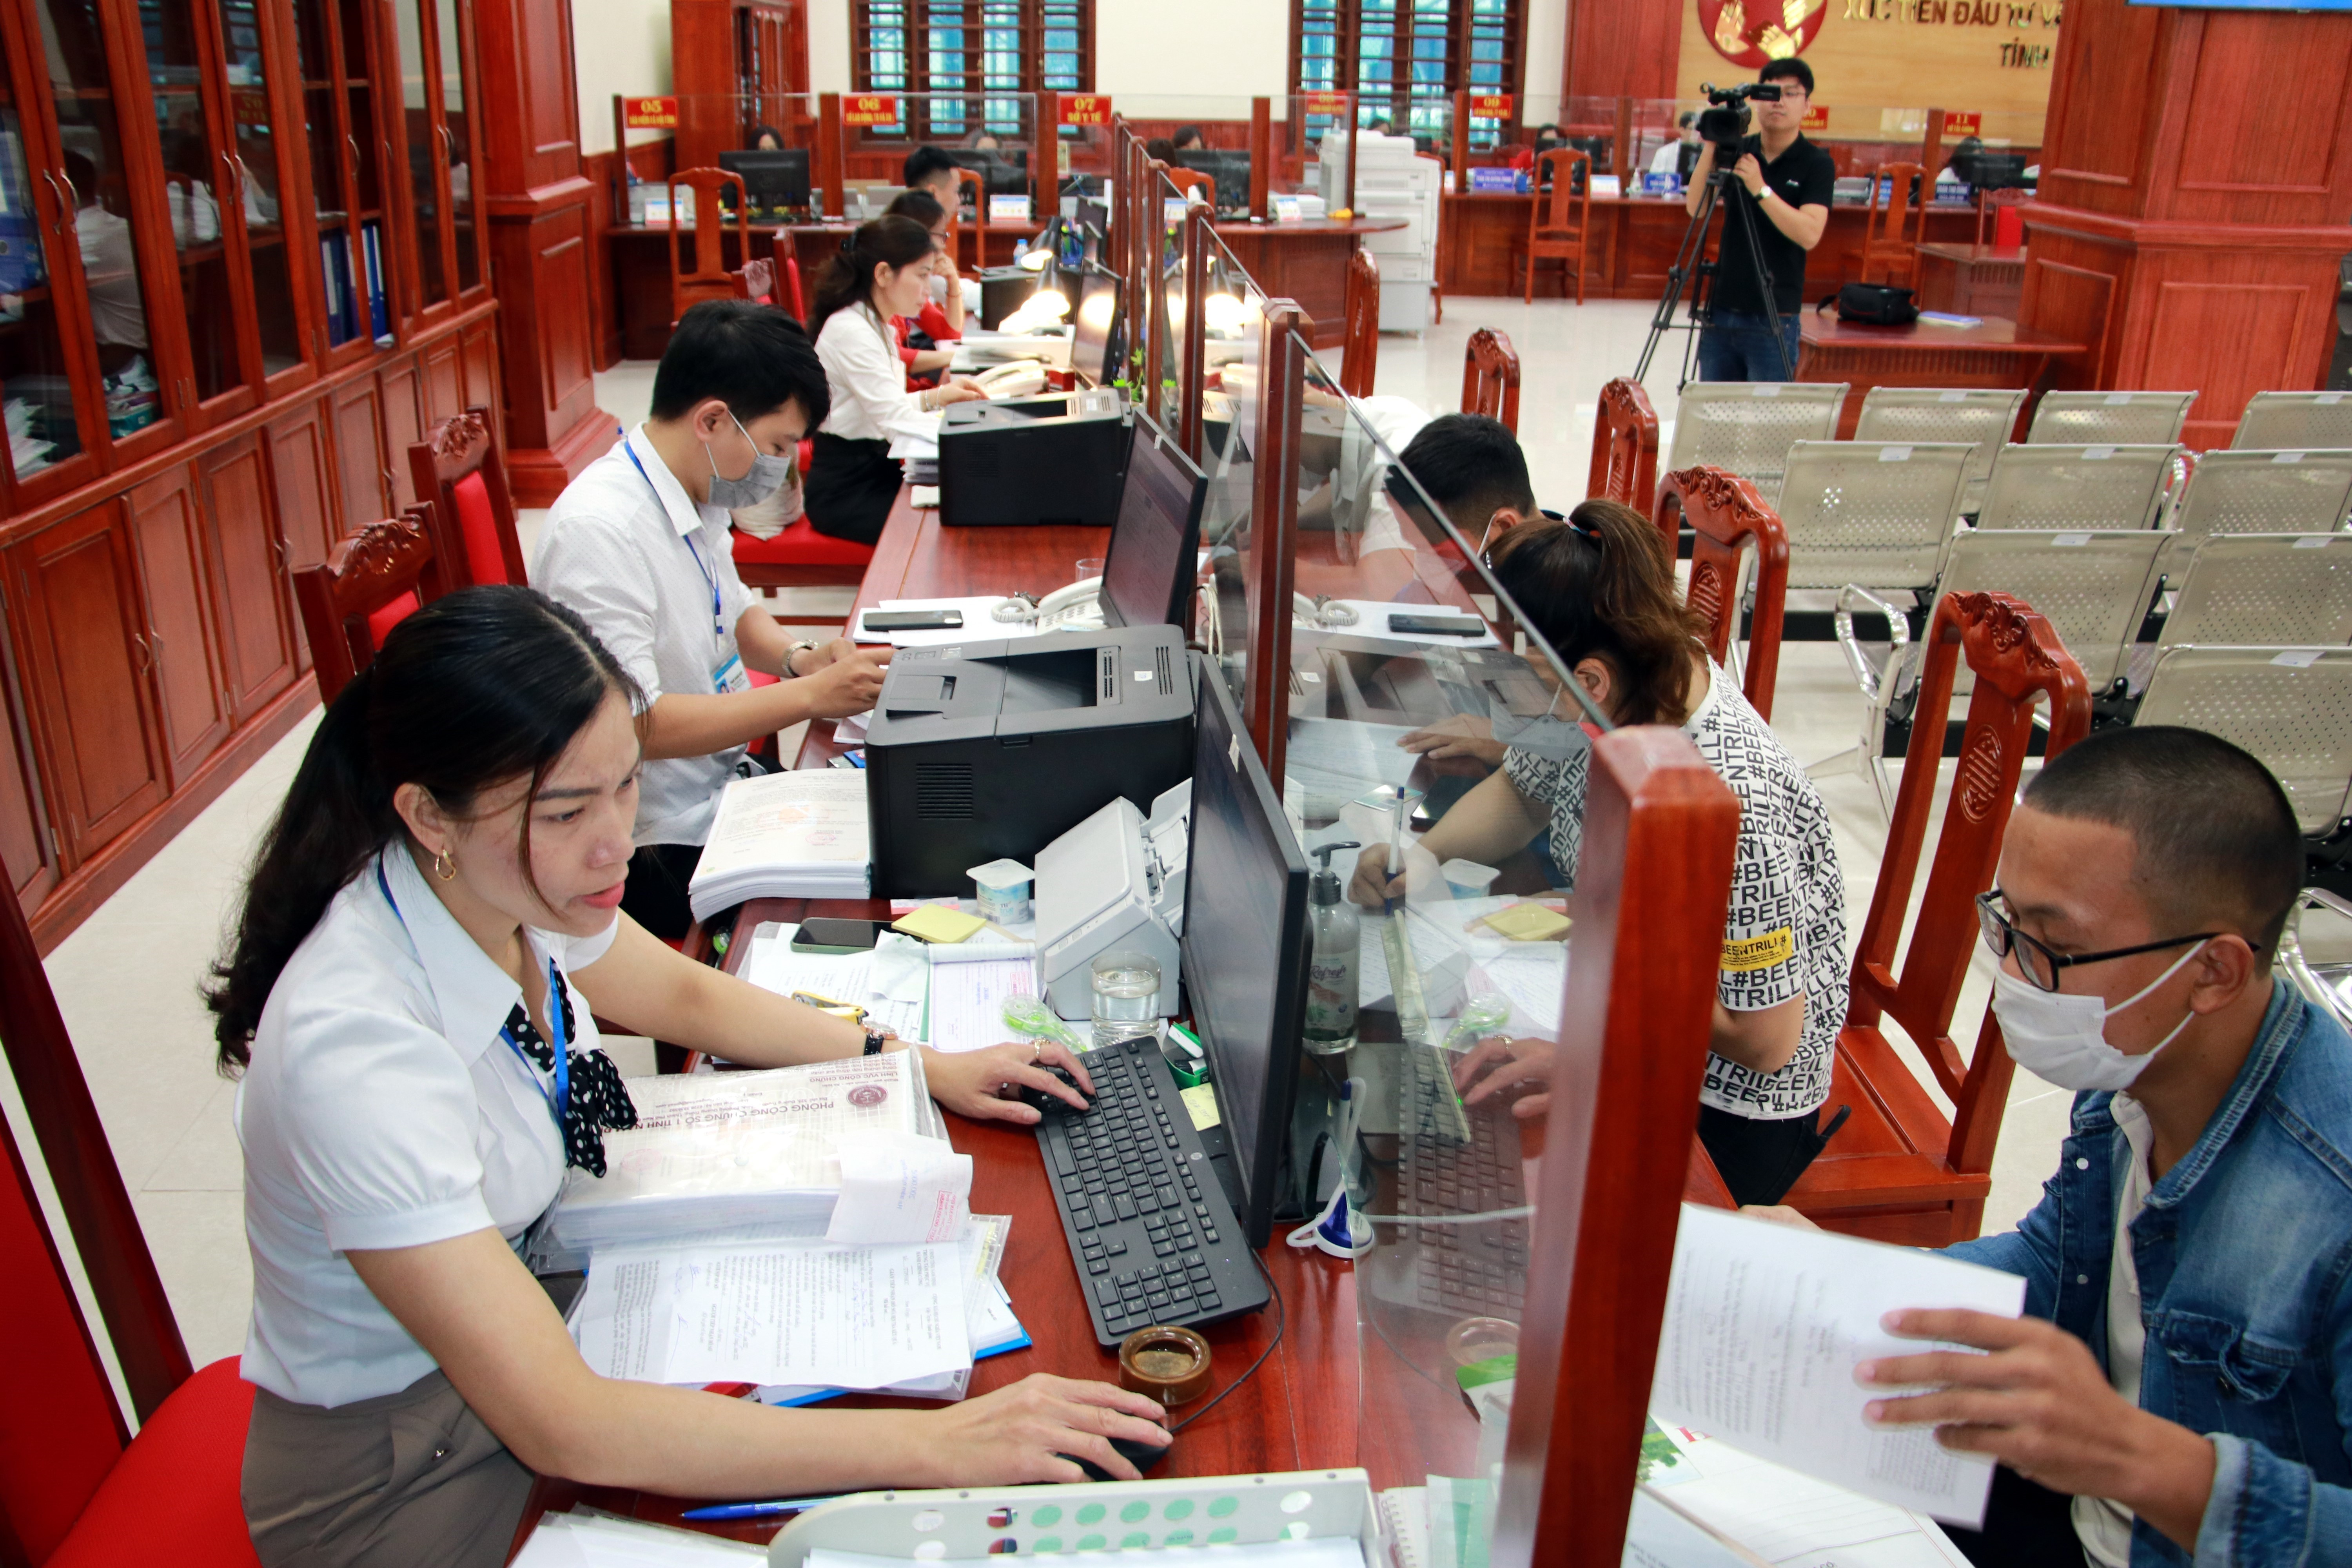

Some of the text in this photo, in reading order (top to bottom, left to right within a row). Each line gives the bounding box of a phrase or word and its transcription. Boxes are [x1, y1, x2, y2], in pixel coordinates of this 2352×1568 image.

[2000, 36, 2049, 68] TỈNH
[641, 100, 663, 113] 05
[858, 97, 880, 111] 06
[1074, 97, 1095, 111] 07
[1483, 96, 1500, 107] 09
[1067, 111, 1080, 122] SỞ
[1082, 113, 1088, 122] Y
[1311, 964, 1347, 981] Refresh
[750, 1105, 788, 1117] CÔNG
[791, 1101, 834, 1113] PHÒNG
[647, 1119, 672, 1129] TỈNH
